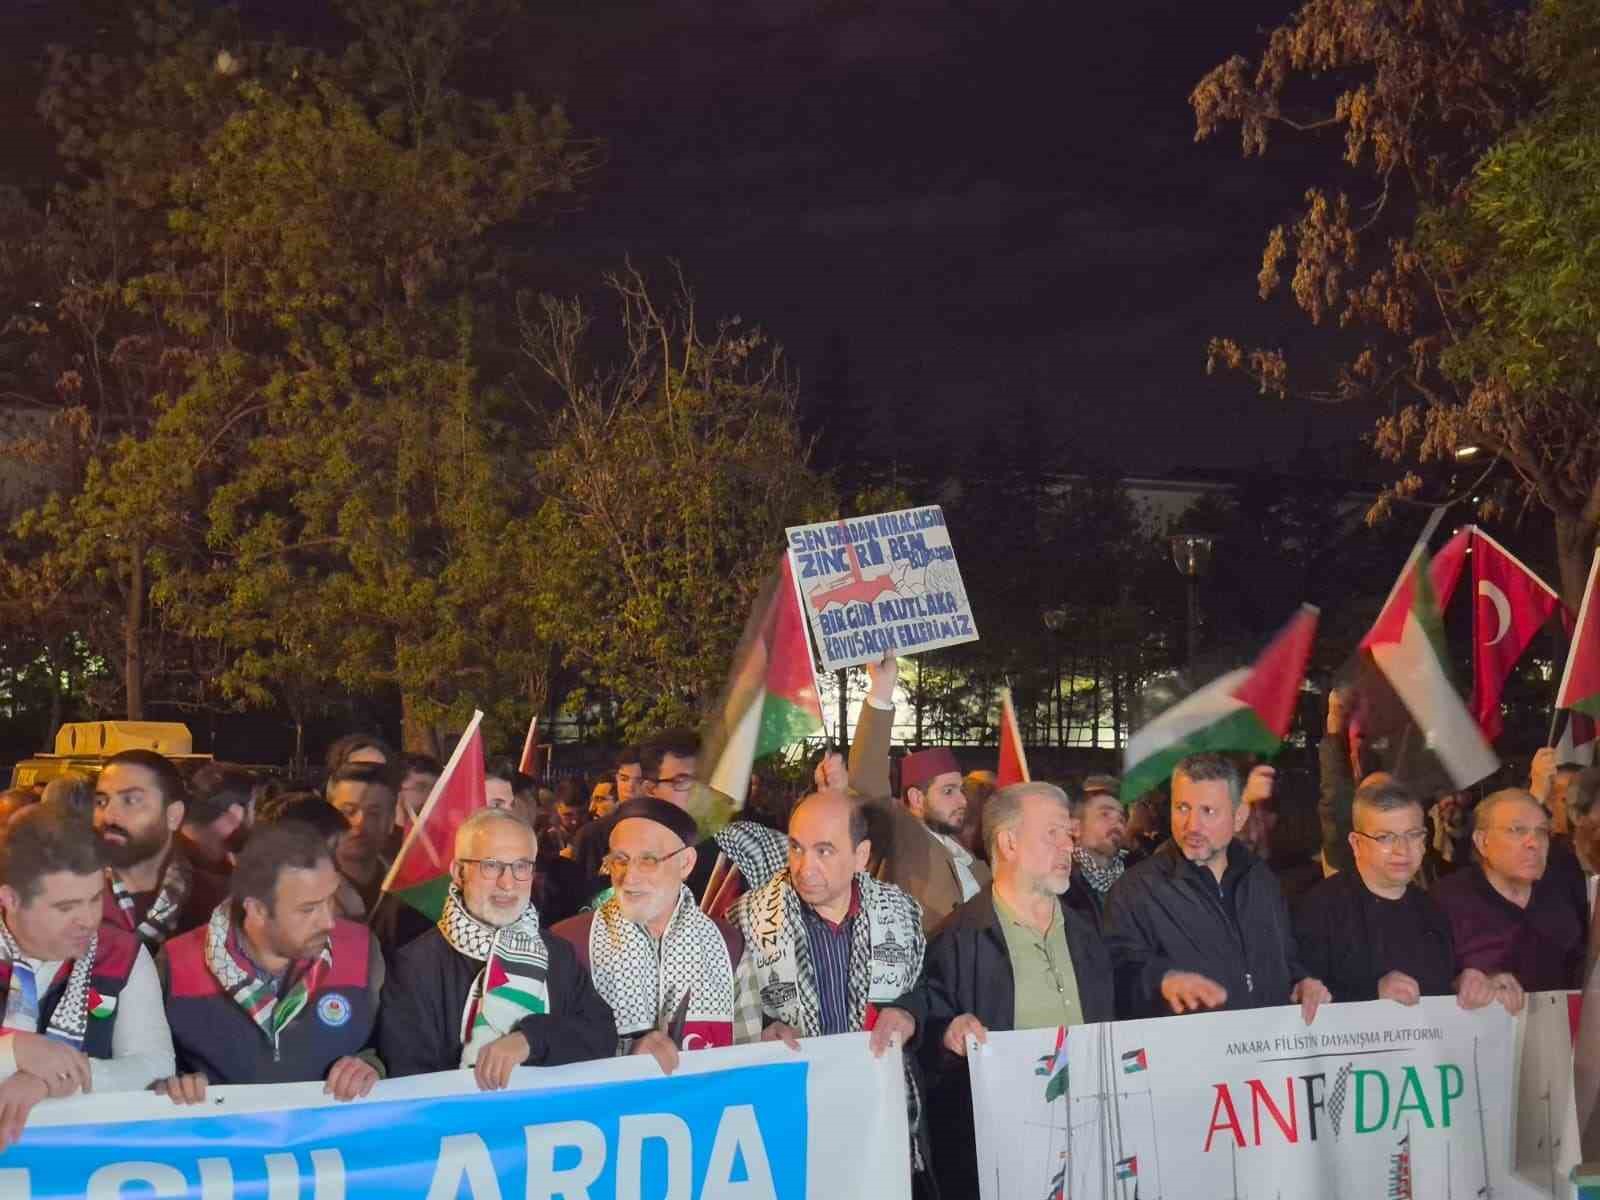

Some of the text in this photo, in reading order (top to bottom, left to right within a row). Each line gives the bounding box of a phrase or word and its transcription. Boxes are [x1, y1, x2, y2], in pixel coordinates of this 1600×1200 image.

[790, 527, 826, 552] SEN
[879, 592, 958, 623] MUTLAKA
[1226, 1039, 1271, 1056] ANKARA
